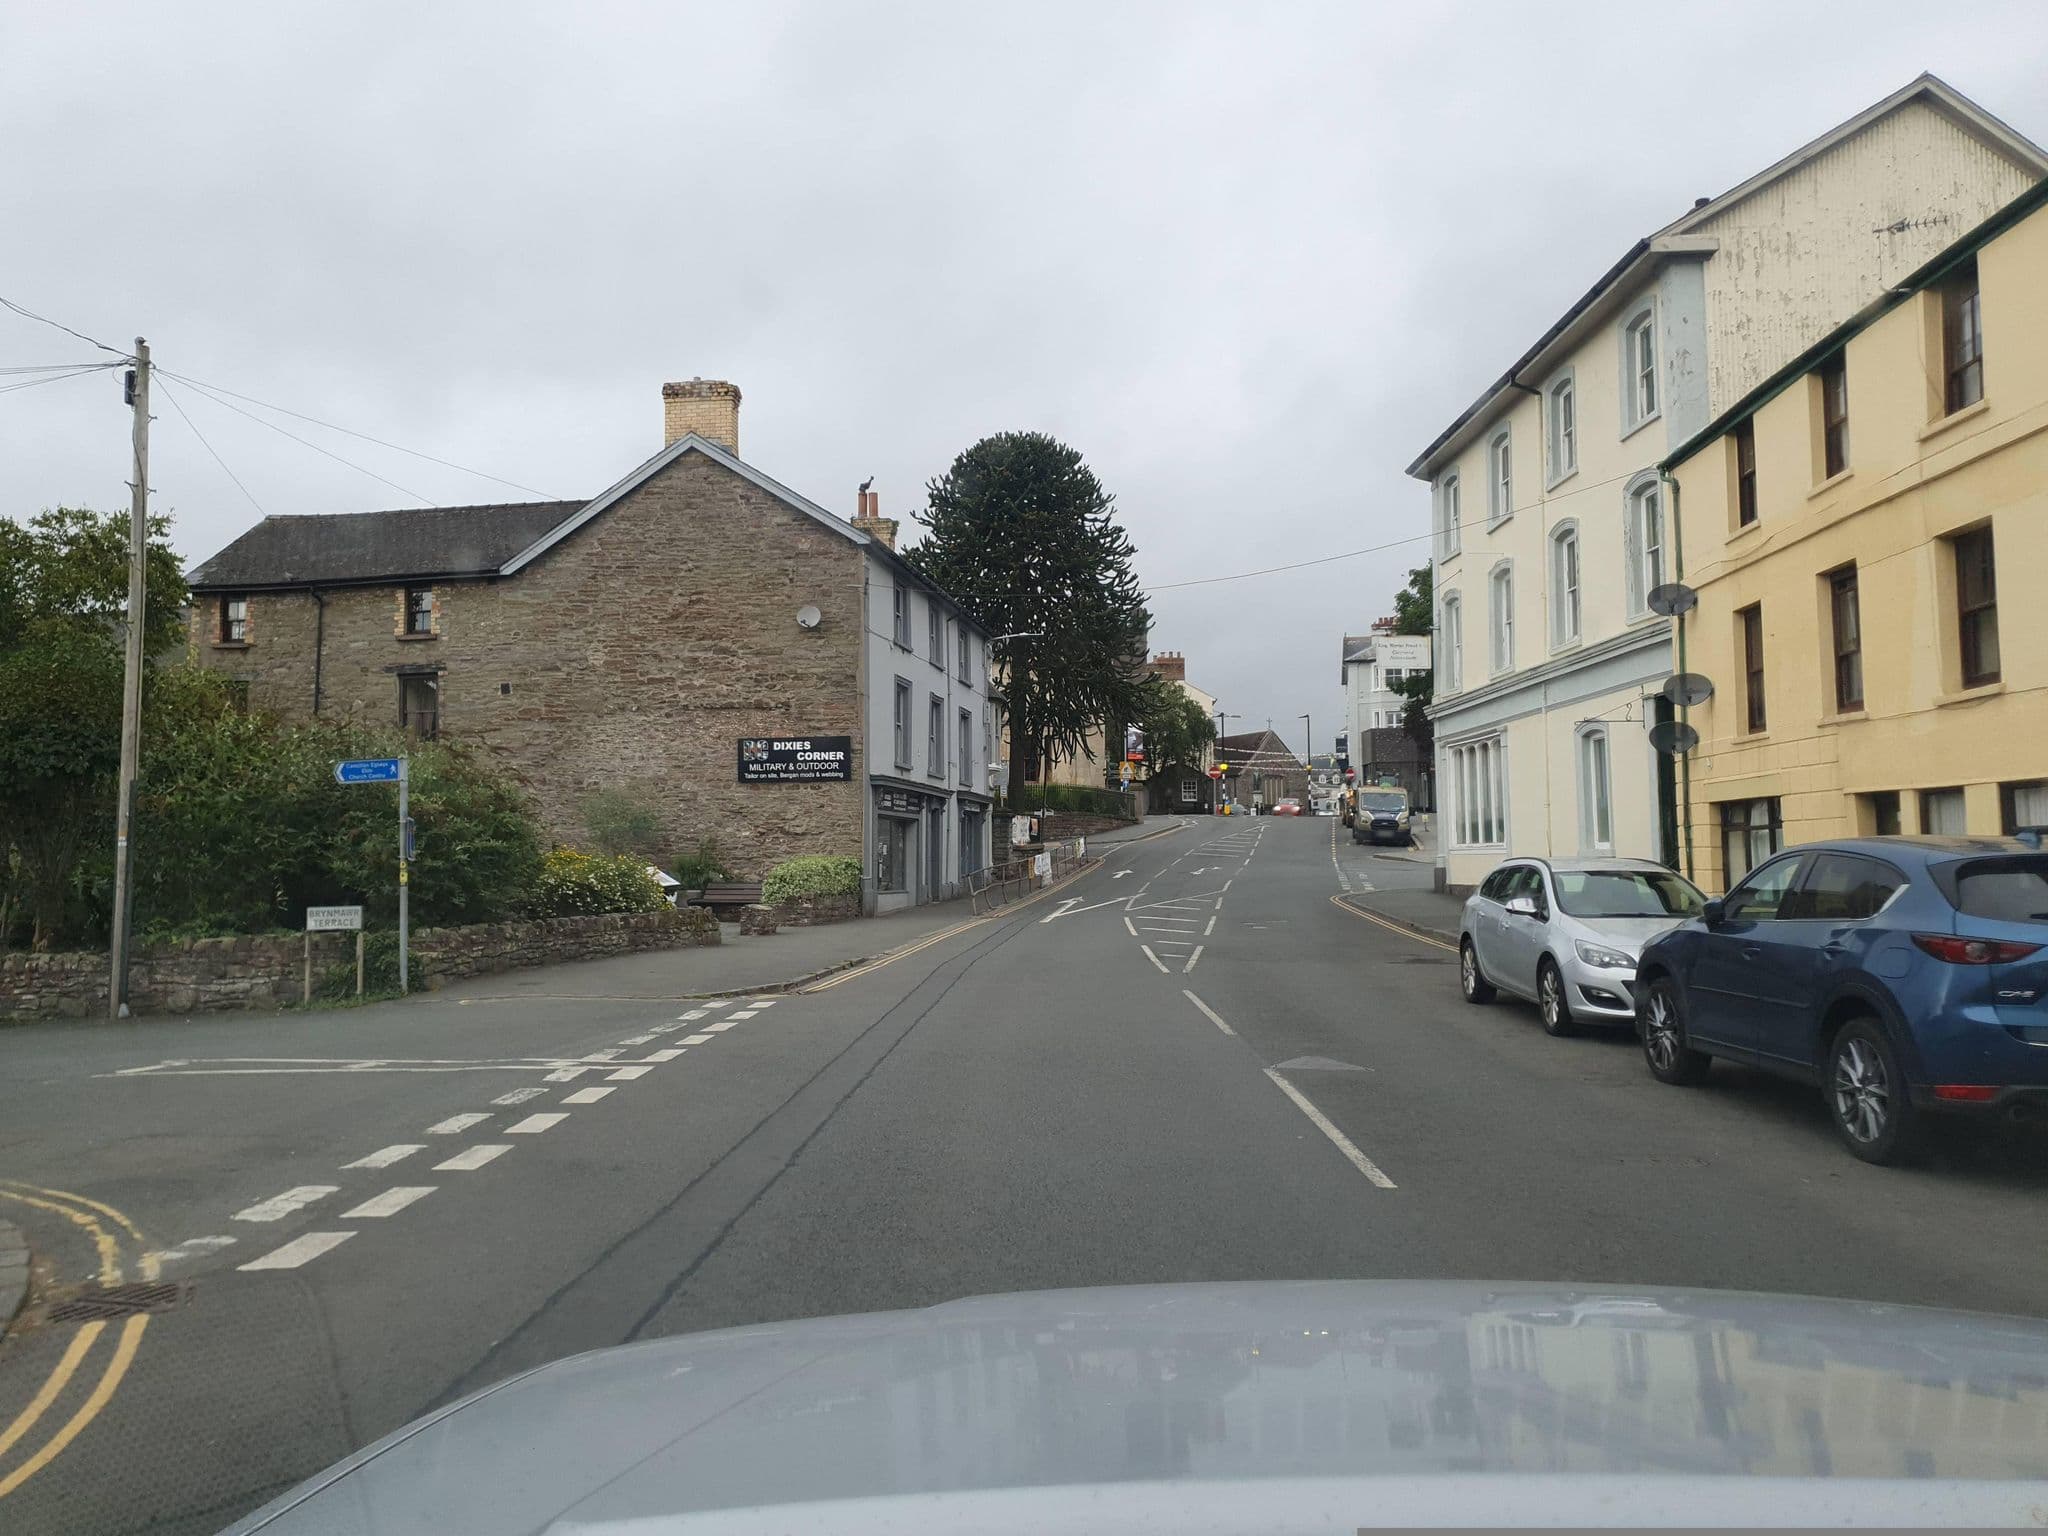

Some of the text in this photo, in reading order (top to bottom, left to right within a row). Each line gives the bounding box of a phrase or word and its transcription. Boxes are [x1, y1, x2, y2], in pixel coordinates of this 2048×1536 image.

[773, 741, 811, 751] DIXIES
[797, 751, 844, 761] CORNER
[749, 762, 839, 772] MILITARY & OUTDOOR
[313, 919, 354, 928] TERRACE
